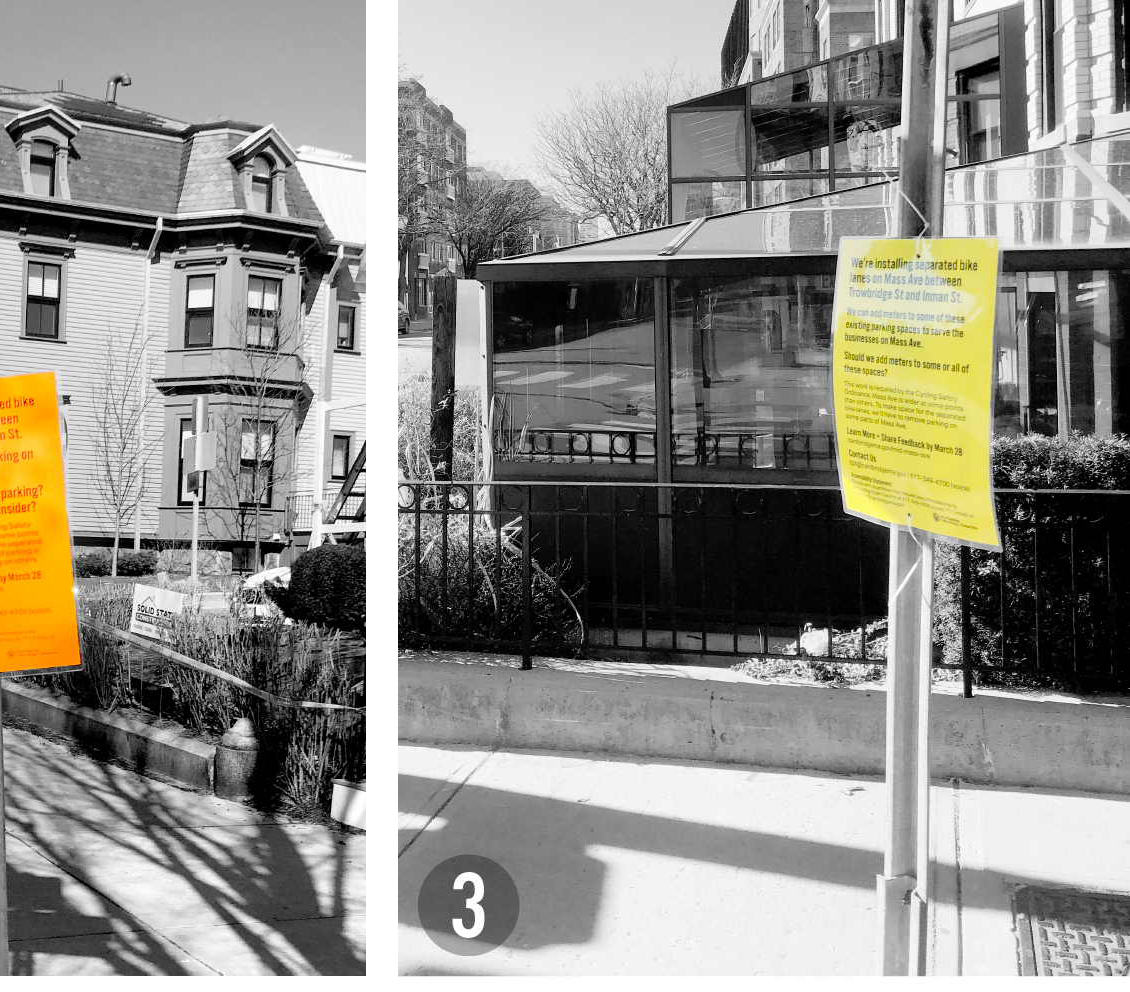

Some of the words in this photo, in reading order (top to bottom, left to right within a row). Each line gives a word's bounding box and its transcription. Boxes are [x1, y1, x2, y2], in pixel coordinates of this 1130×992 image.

[852, 258, 873, 268] We're
[875, 258, 913, 271] installing
[915, 261, 957, 272] separated
[959, 260, 978, 271] bike
[850, 273, 870, 283] lanes
[872, 275, 882, 283] on
[884, 275, 906, 284] Mass
[908, 275, 923, 285] Ave
[925, 275, 962, 287] between
[849, 287, 892, 301] Trowbridge
[894, 289, 904, 299] St
[905, 290, 920, 300] and
[923, 291, 948, 302] Inman
[951, 292, 963, 303] St.
[14, 396, 35, 408] bike
[8, 428, 23, 440] St.
[137, 604, 154, 614] SOLID
[156, 609, 172, 618] STAT
